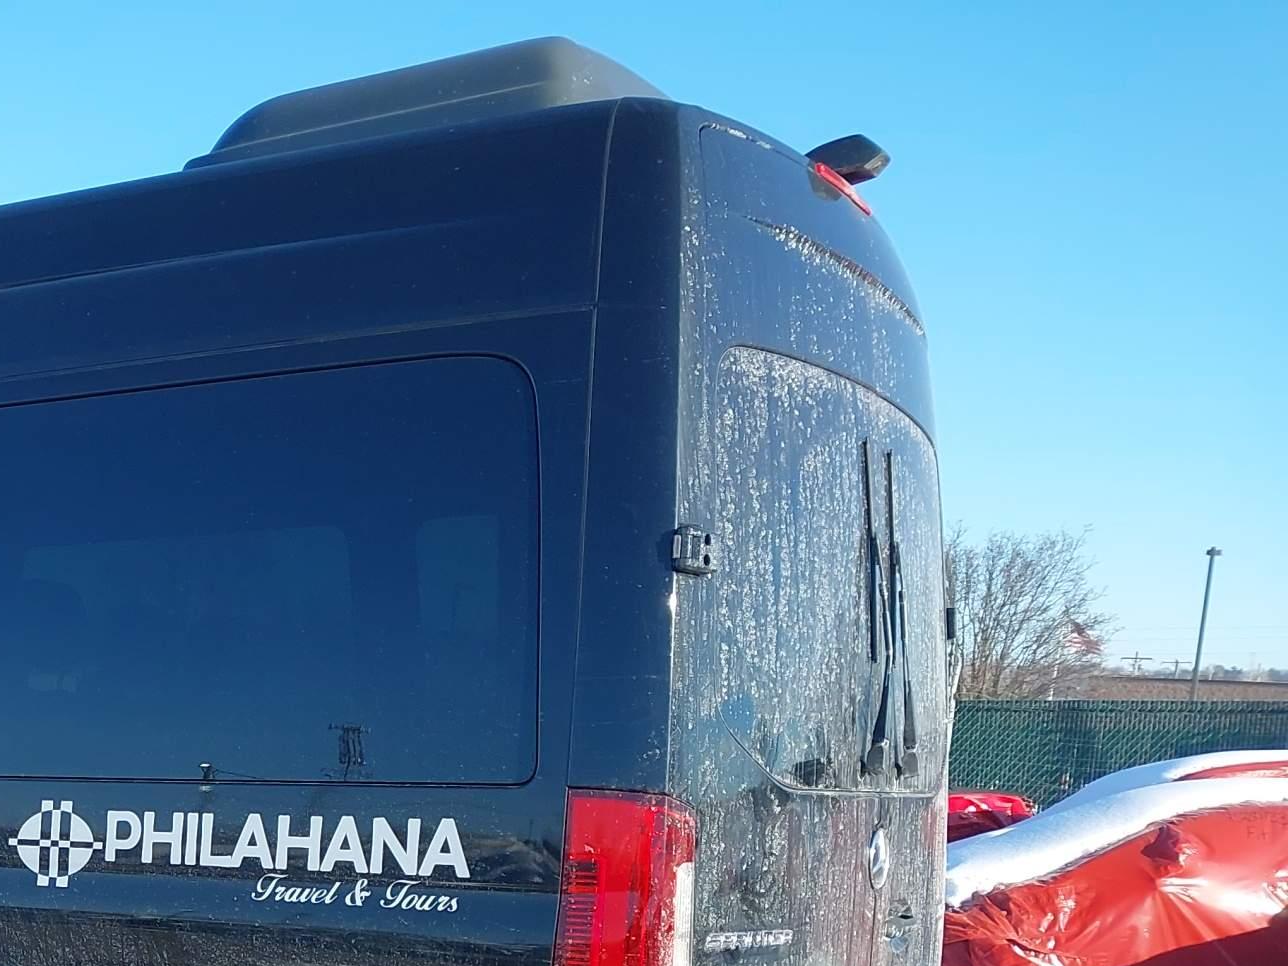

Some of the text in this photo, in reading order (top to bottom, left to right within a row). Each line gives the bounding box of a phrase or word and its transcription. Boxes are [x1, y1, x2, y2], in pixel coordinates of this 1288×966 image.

[104, 809, 472, 879] PHILAHANA
[251, 873, 459, 913] Travel & Tours
